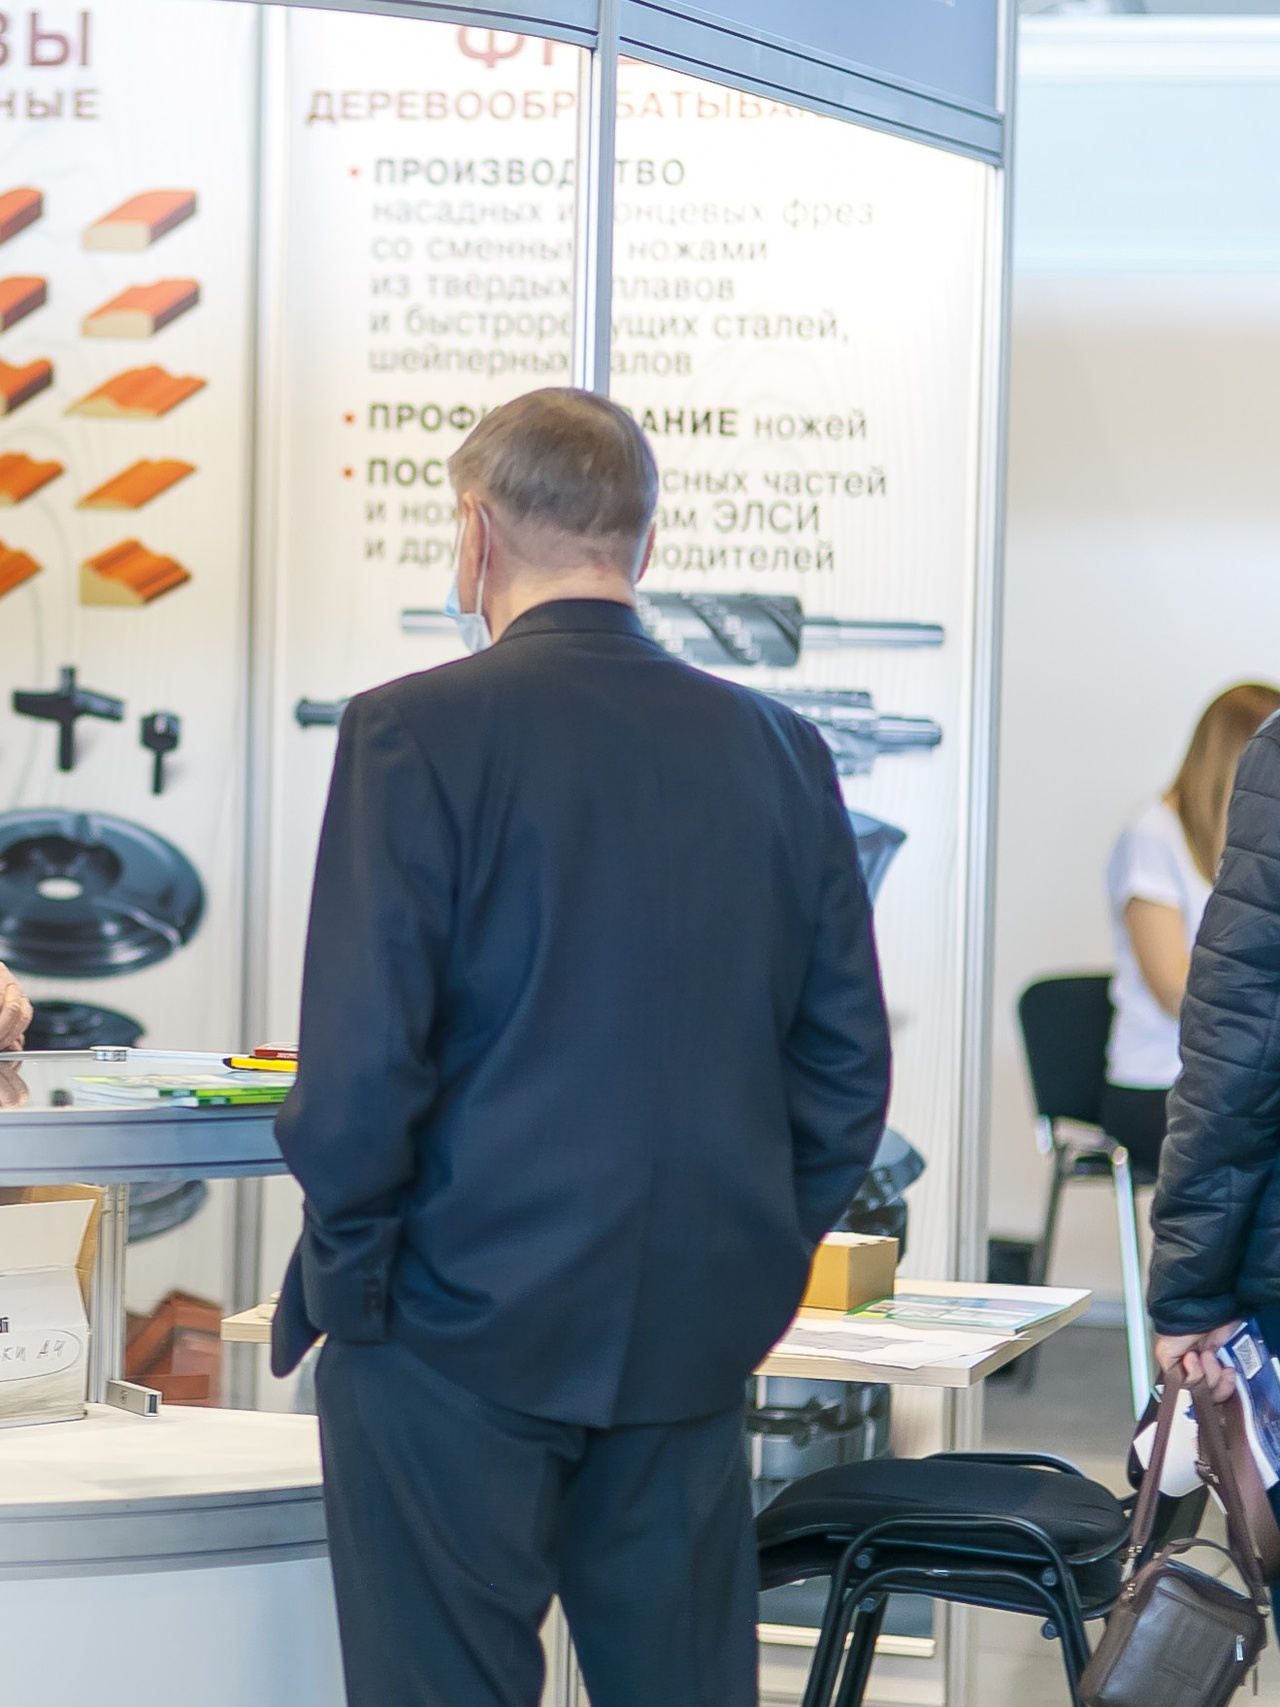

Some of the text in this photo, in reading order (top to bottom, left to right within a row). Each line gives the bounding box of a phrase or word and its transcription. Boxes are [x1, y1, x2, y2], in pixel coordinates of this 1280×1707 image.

[305, 89, 826, 125] ДЕРЕВООБРБАТЫВ
[373, 157, 685, 189] ПРОИЗВОДТВО
[372, 201, 543, 228] насадных
[613, 201, 763, 227] онцевых
[781, 198, 874, 229] фрез
[371, 237, 769, 263] со сменны ножами
[371, 275, 410, 297] из
[613, 276, 736, 300] плавов
[371, 302, 849, 347] и быстрореущих сталей,
[610, 350, 692, 376] алов
[754, 409, 867, 440] ножей
[368, 458, 887, 498] ПОС сных частей
[367, 500, 387, 523] и
[654, 507, 699, 531] ам
[713, 500, 821, 534] ЭЛСИ
[365, 537, 385, 561] и
[656, 541, 835, 573] одителей
